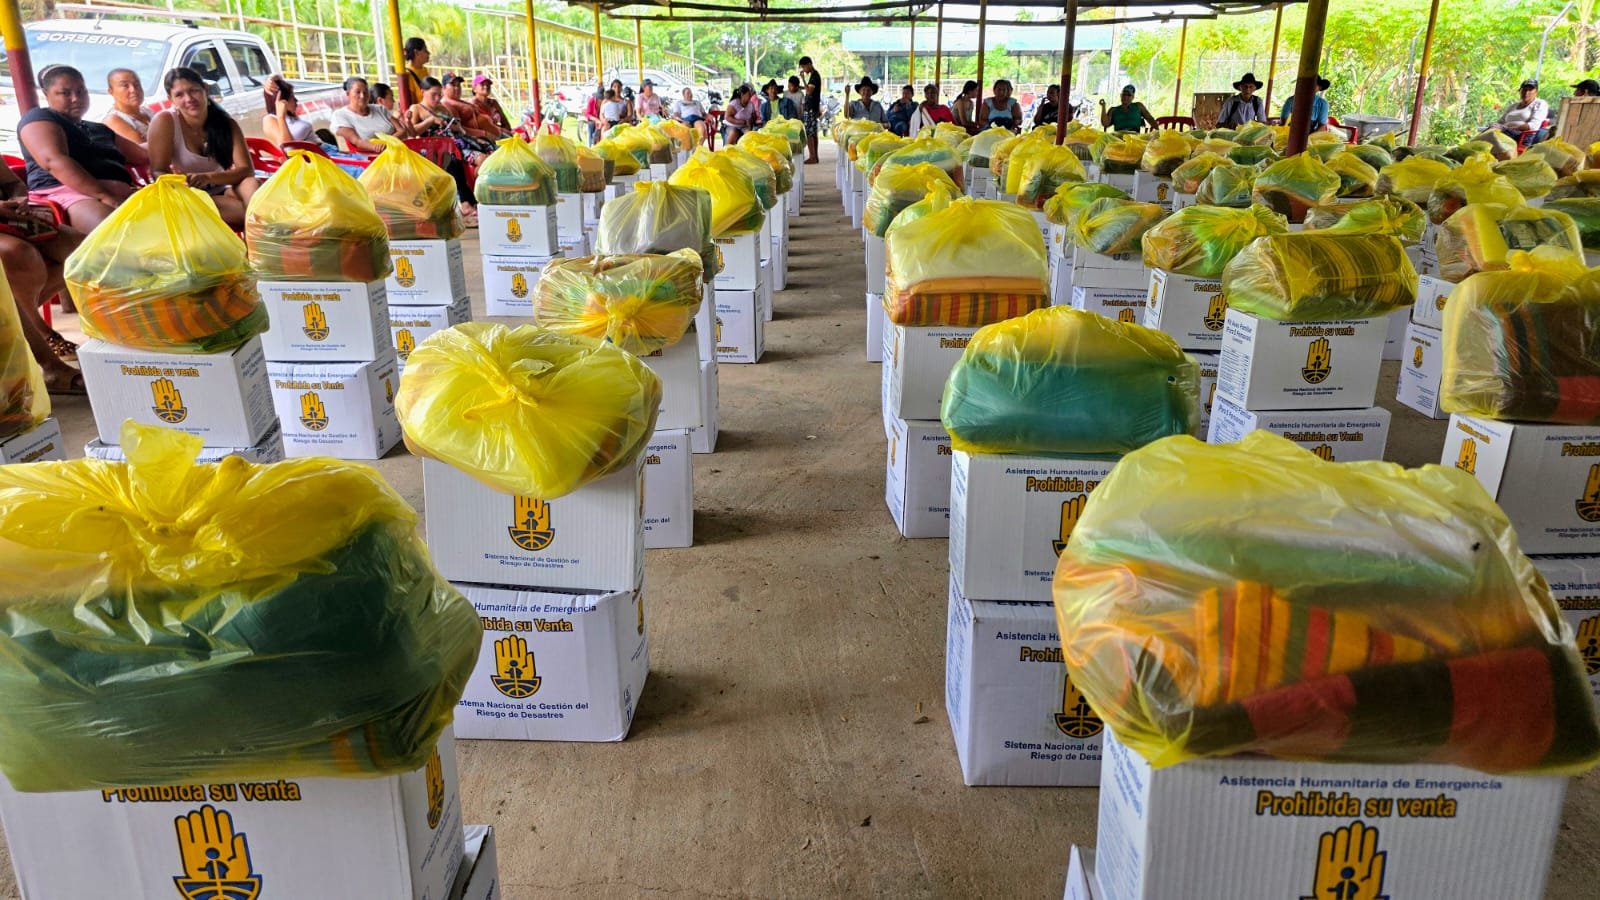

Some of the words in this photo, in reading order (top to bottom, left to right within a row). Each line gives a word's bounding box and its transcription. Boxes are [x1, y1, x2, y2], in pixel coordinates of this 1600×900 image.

[647, 444, 677, 452] ergencia
[1561, 442, 1600, 456] Prohib
[646, 454, 661, 464] nta
[1026, 476, 1084, 492] Prohibida
[475, 602, 527, 612] Humanitaria
[544, 605, 596, 614] Emergencia
[1556, 596, 1600, 610] ohibid
[480, 617, 513, 631] ibida
[514, 620, 532, 631] su
[534, 618, 573, 632] Venta
[996, 632, 1046, 641] Asistencia
[486, 701, 524, 710] Nacional
[539, 702, 573, 710] Gestión
[476, 709, 506, 718] Riesgo
[1004, 740, 1042, 750] Sistema
[1044, 743, 1084, 751] Nacional
[1031, 752, 1063, 761] Riesgo
[1220, 776, 1296, 787] Asistencia
[1300, 777, 1387, 789] Humanitaria
[1393, 778, 1410, 789] de
[1415, 778, 1502, 791] Emergencia
[102, 784, 206, 802] Prohibida
[210, 784, 236, 801] su
[240, 780, 301, 801] venta
[1256, 790, 1360, 816] Prohibida
[1364, 797, 1392, 818] su
[1397, 793, 1458, 818] venta
